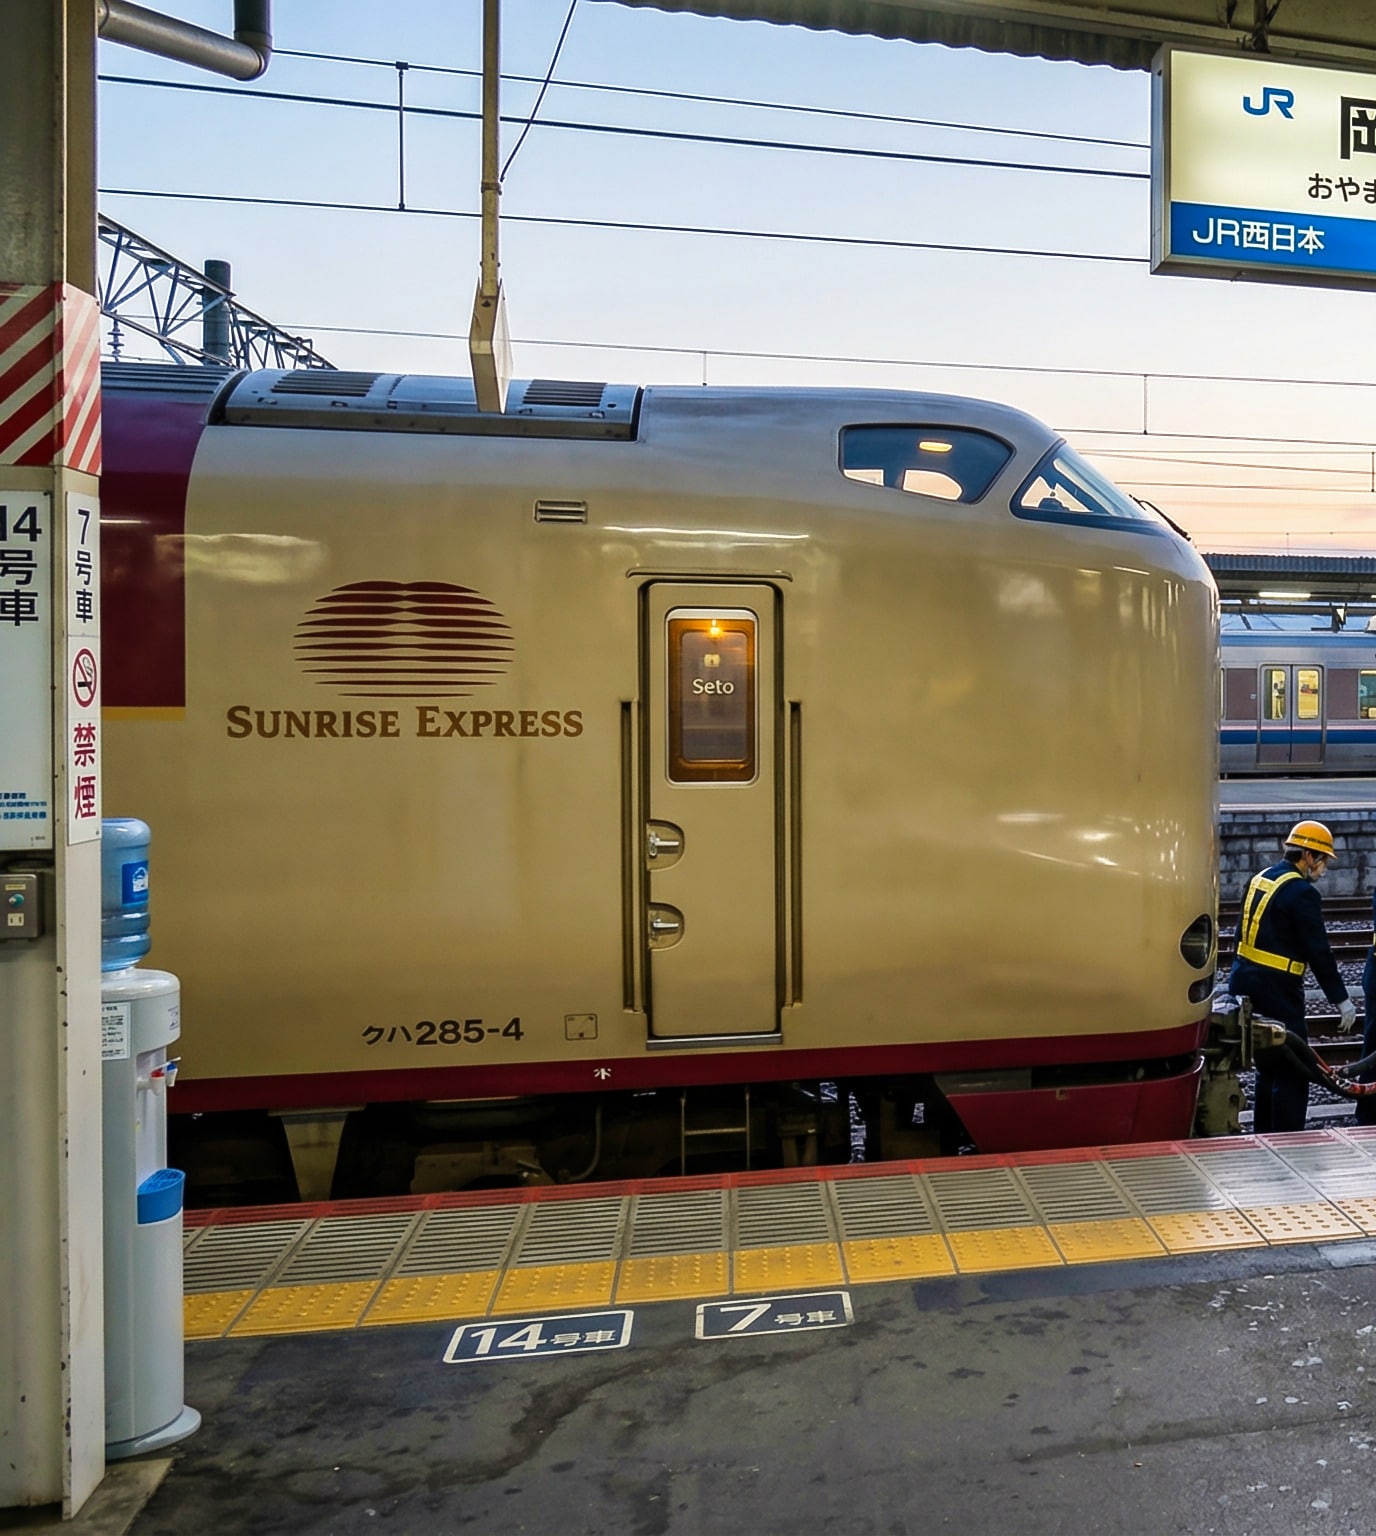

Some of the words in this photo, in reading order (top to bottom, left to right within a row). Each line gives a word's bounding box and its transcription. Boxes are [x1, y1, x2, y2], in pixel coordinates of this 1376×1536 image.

[1243, 87, 1295, 119] JR
[1192, 217, 1326, 254] JR西日本
[692, 678, 735, 696] Seto
[226, 704, 401, 739] SUNRISE
[416, 704, 584, 738] EXPRESS
[361, 1017, 525, 1046] クハ285-4
